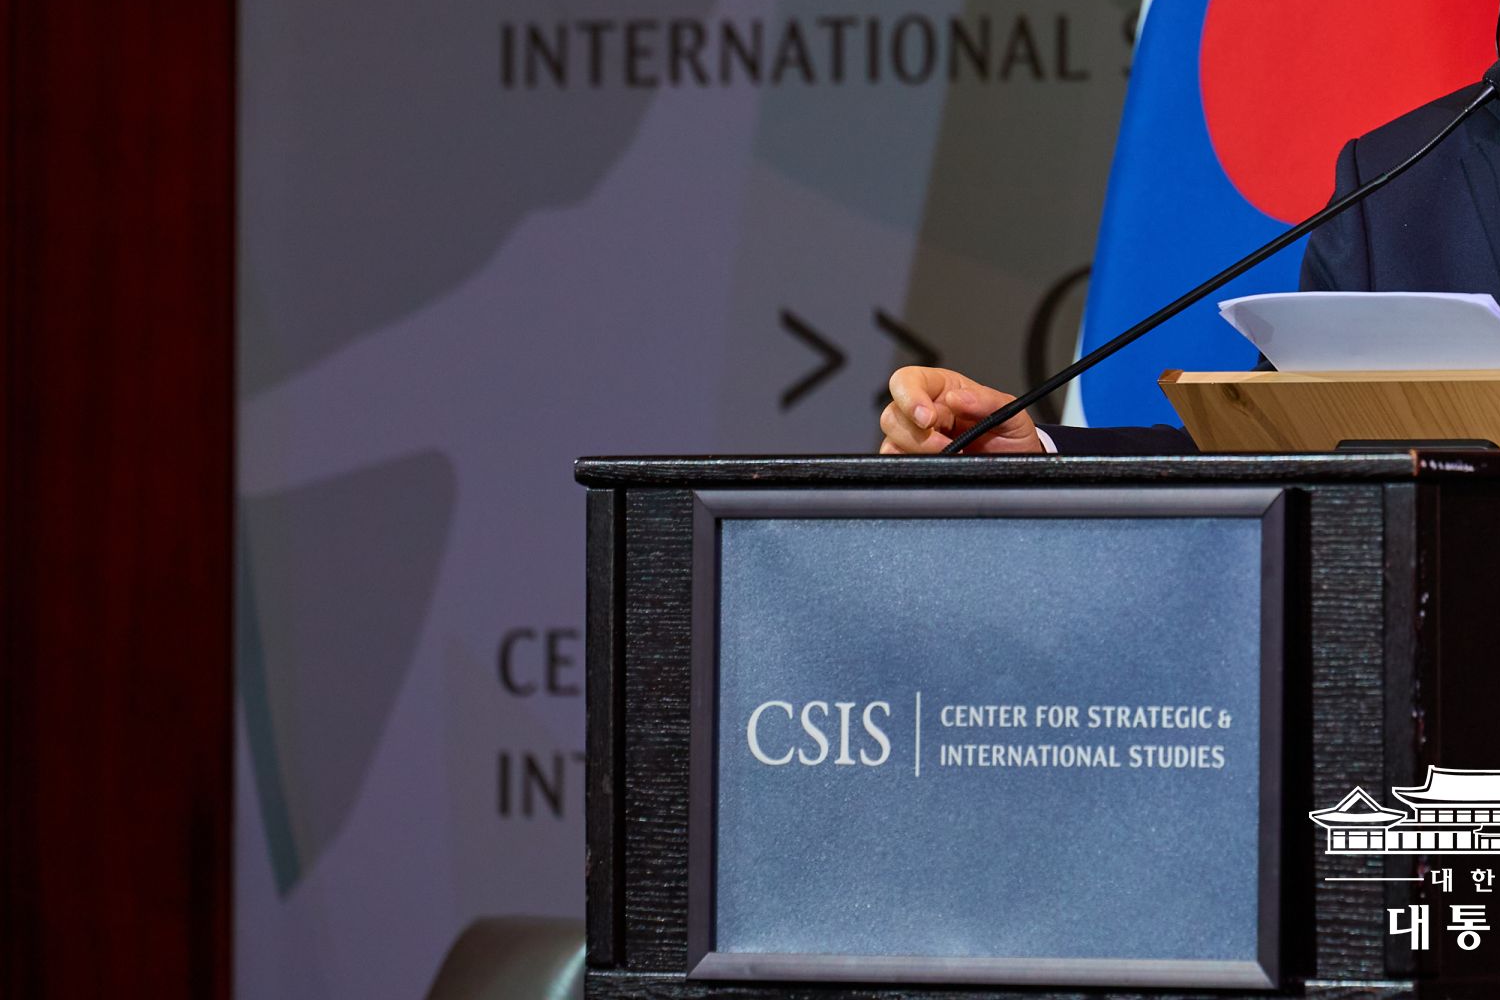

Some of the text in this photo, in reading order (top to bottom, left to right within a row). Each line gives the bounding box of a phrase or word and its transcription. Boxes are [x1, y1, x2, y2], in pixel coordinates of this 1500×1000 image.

[500, 13, 1090, 89] INTERNATIONAL
[747, 700, 892, 767] CSIS
[940, 704, 1233, 730] CENTER FOR STRATEGIC &
[940, 743, 1227, 770] INTERNATIONAL STUDIES
